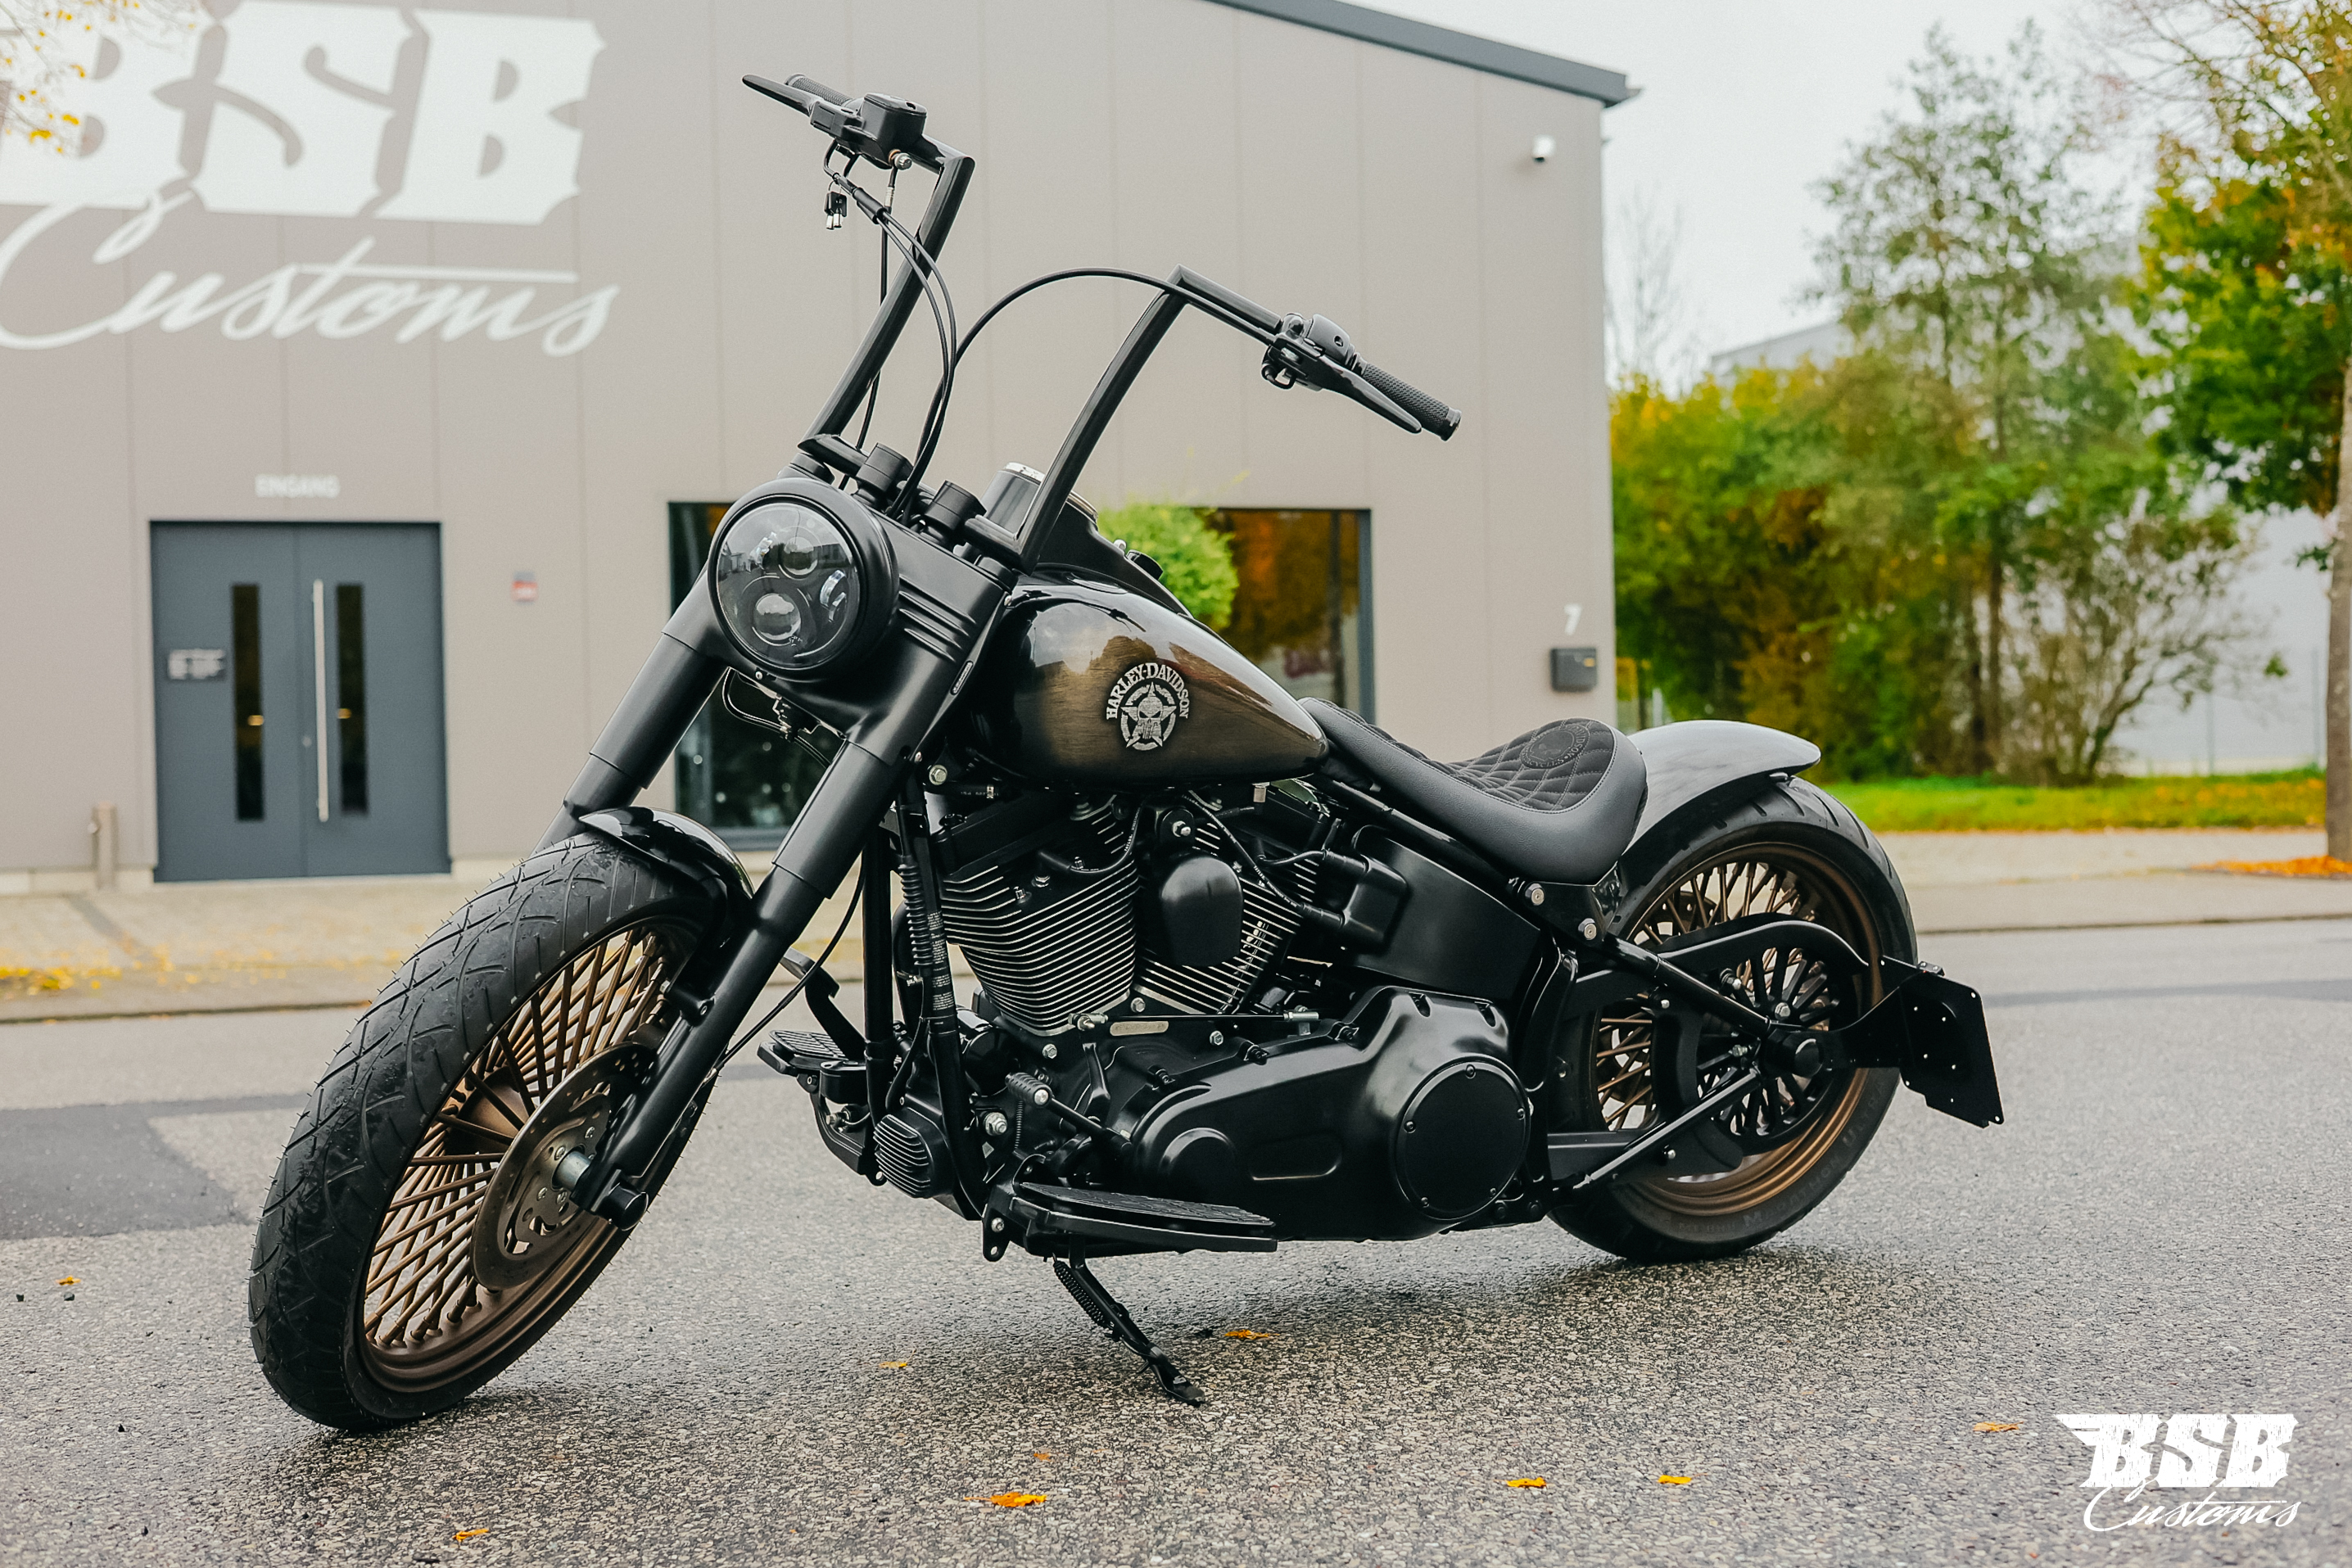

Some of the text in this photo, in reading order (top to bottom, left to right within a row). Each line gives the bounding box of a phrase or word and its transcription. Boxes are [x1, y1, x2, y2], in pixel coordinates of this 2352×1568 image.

[0, 0, 607, 225] BSB
[0, 190, 620, 355] Customs
[1563, 603, 1582, 635] 7
[1106, 662, 1189, 720] HARLEY-DAVIDSON
